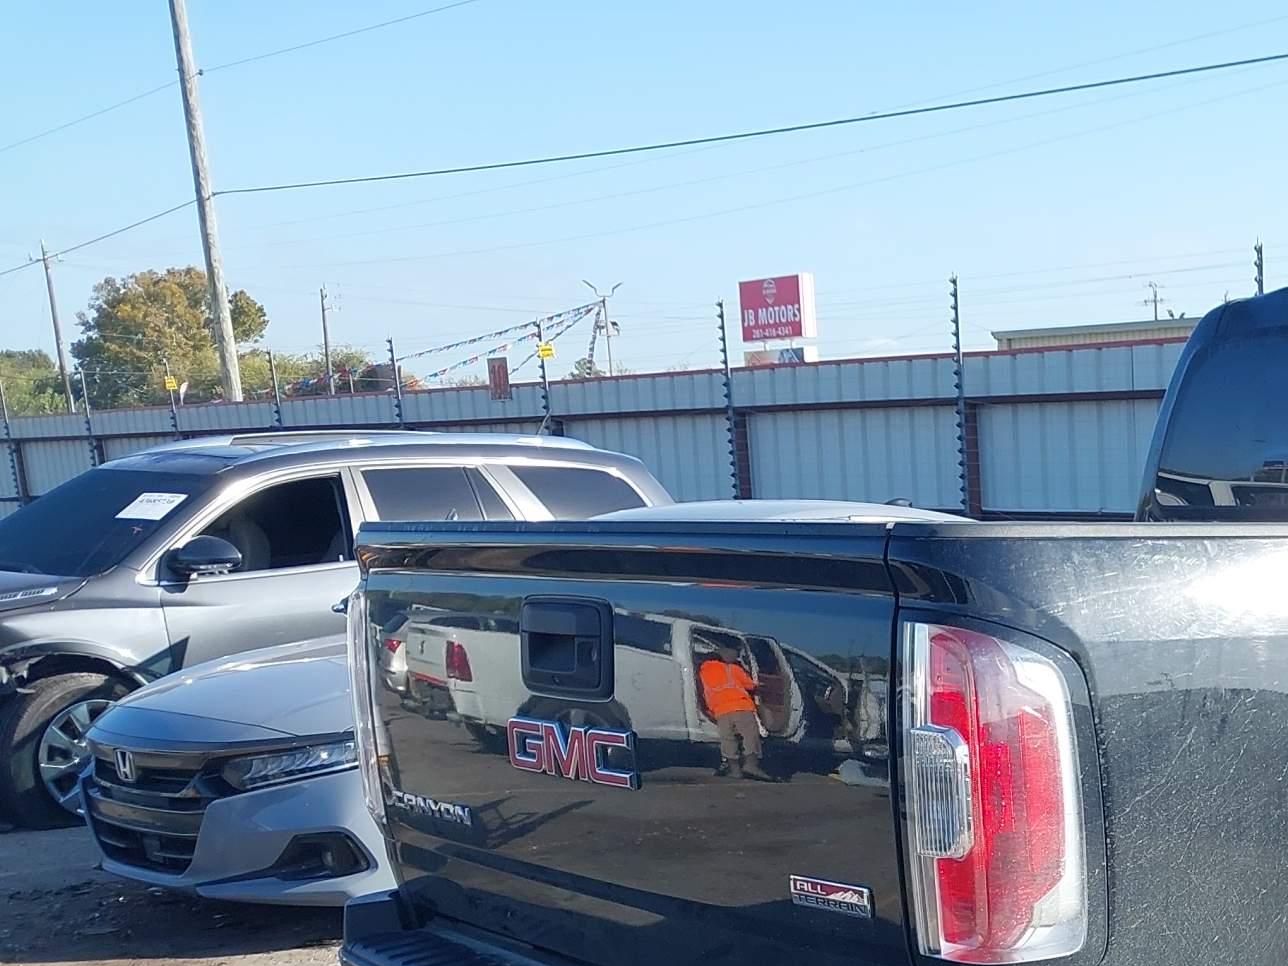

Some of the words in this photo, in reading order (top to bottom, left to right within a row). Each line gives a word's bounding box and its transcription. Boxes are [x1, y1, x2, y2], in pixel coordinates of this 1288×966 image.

[744, 309, 755, 327] JB
[758, 304, 800, 326] MOTORS
[507, 716, 641, 791] GMC
[391, 789, 472, 826] CANYON
[795, 879, 828, 896] ALL
[793, 893, 868, 917] TERRAIN
